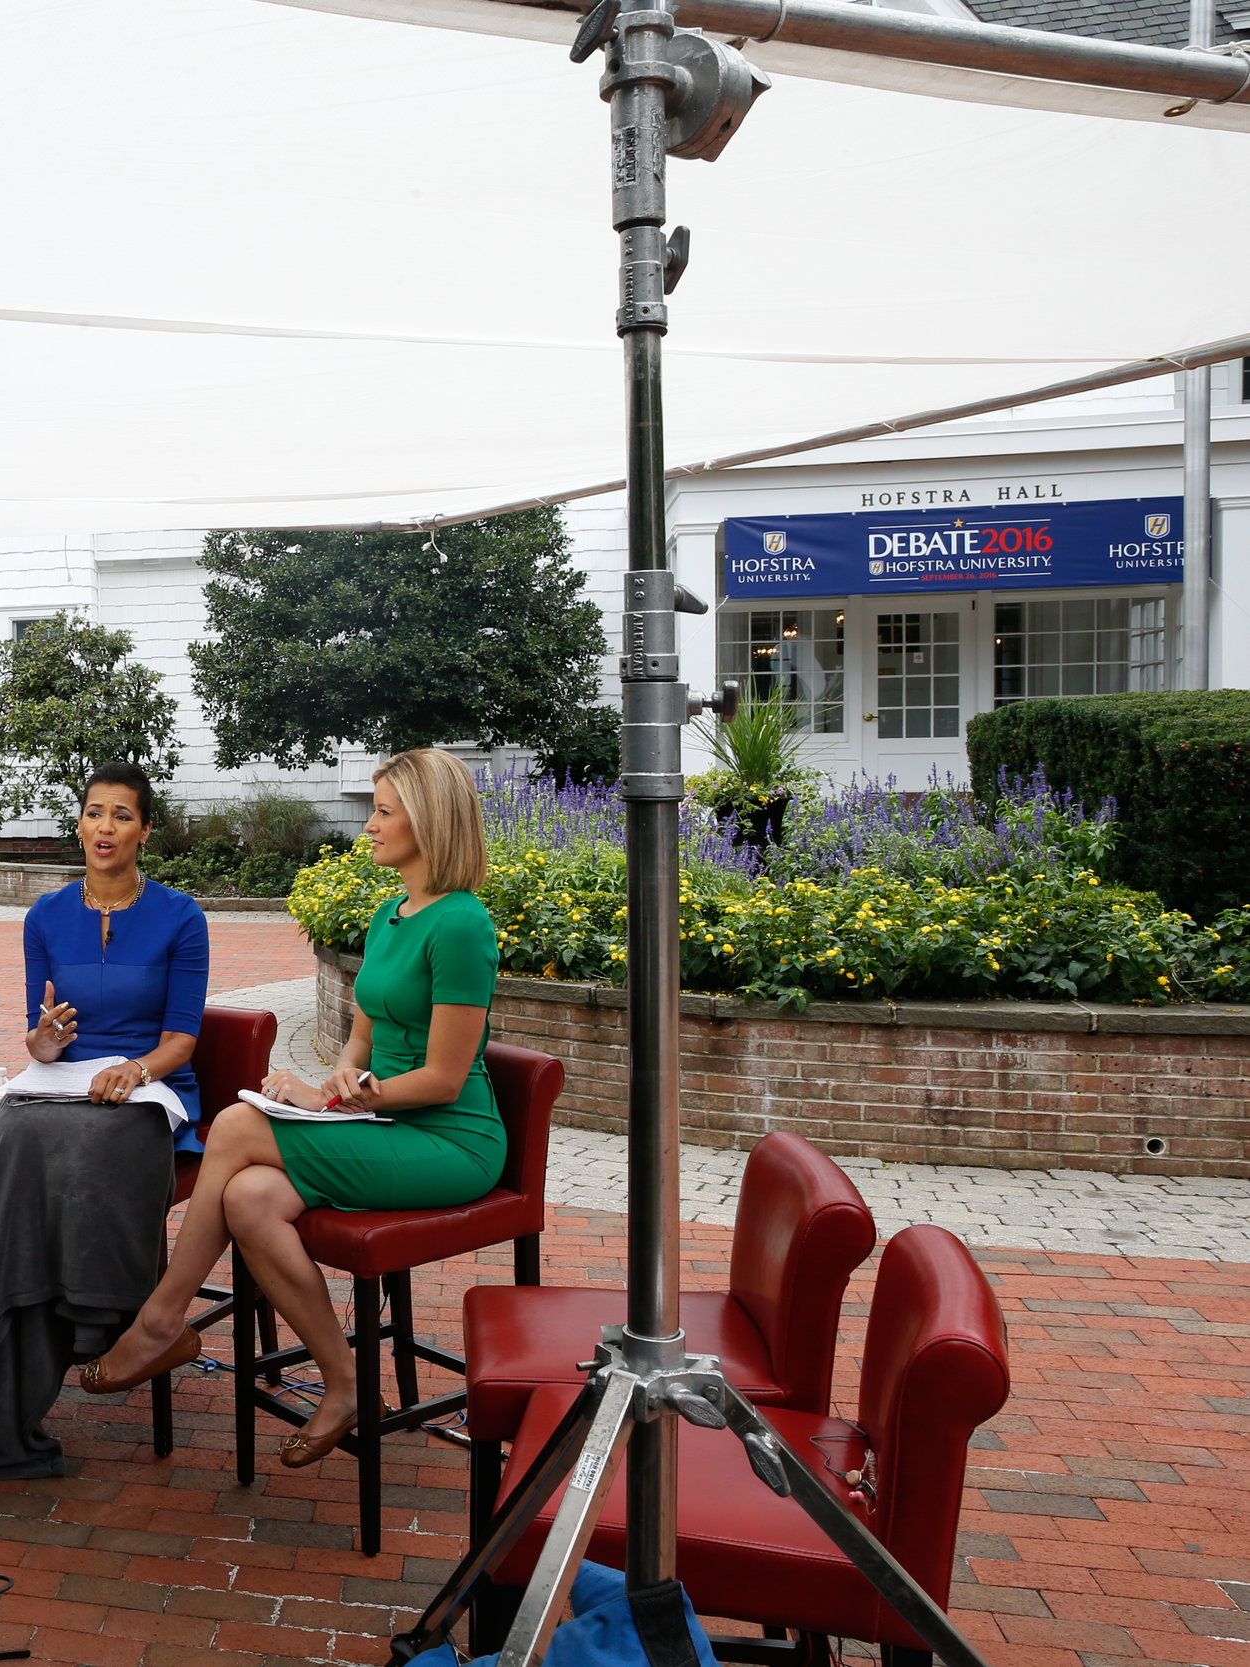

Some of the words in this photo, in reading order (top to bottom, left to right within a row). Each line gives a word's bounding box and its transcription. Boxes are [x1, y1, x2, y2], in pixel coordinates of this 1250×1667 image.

[861, 489, 971, 507] HOFSTRA
[998, 484, 1063, 501] HALL
[732, 557, 816, 573] HOFSTRA
[885, 560, 955, 573] HOFSTRA
[921, 573, 965, 581] SEPTEMBER
[633, 613, 644, 676] AMERICAN
